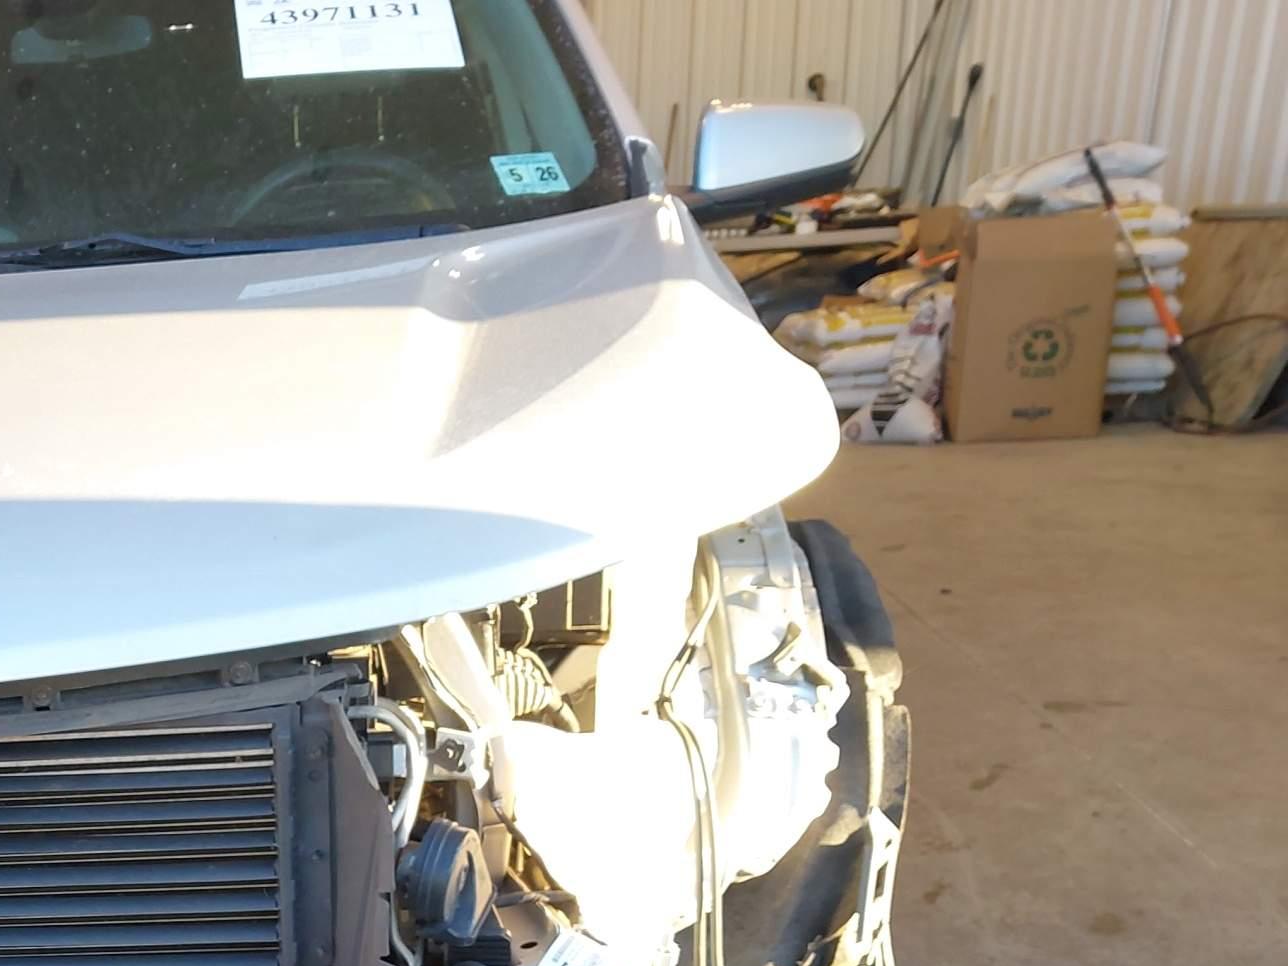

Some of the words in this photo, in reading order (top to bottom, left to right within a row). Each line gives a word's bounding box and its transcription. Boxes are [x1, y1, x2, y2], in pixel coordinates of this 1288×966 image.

[260, 3, 420, 25] 43971131
[508, 167, 523, 182] 5
[535, 166, 559, 182] 26
